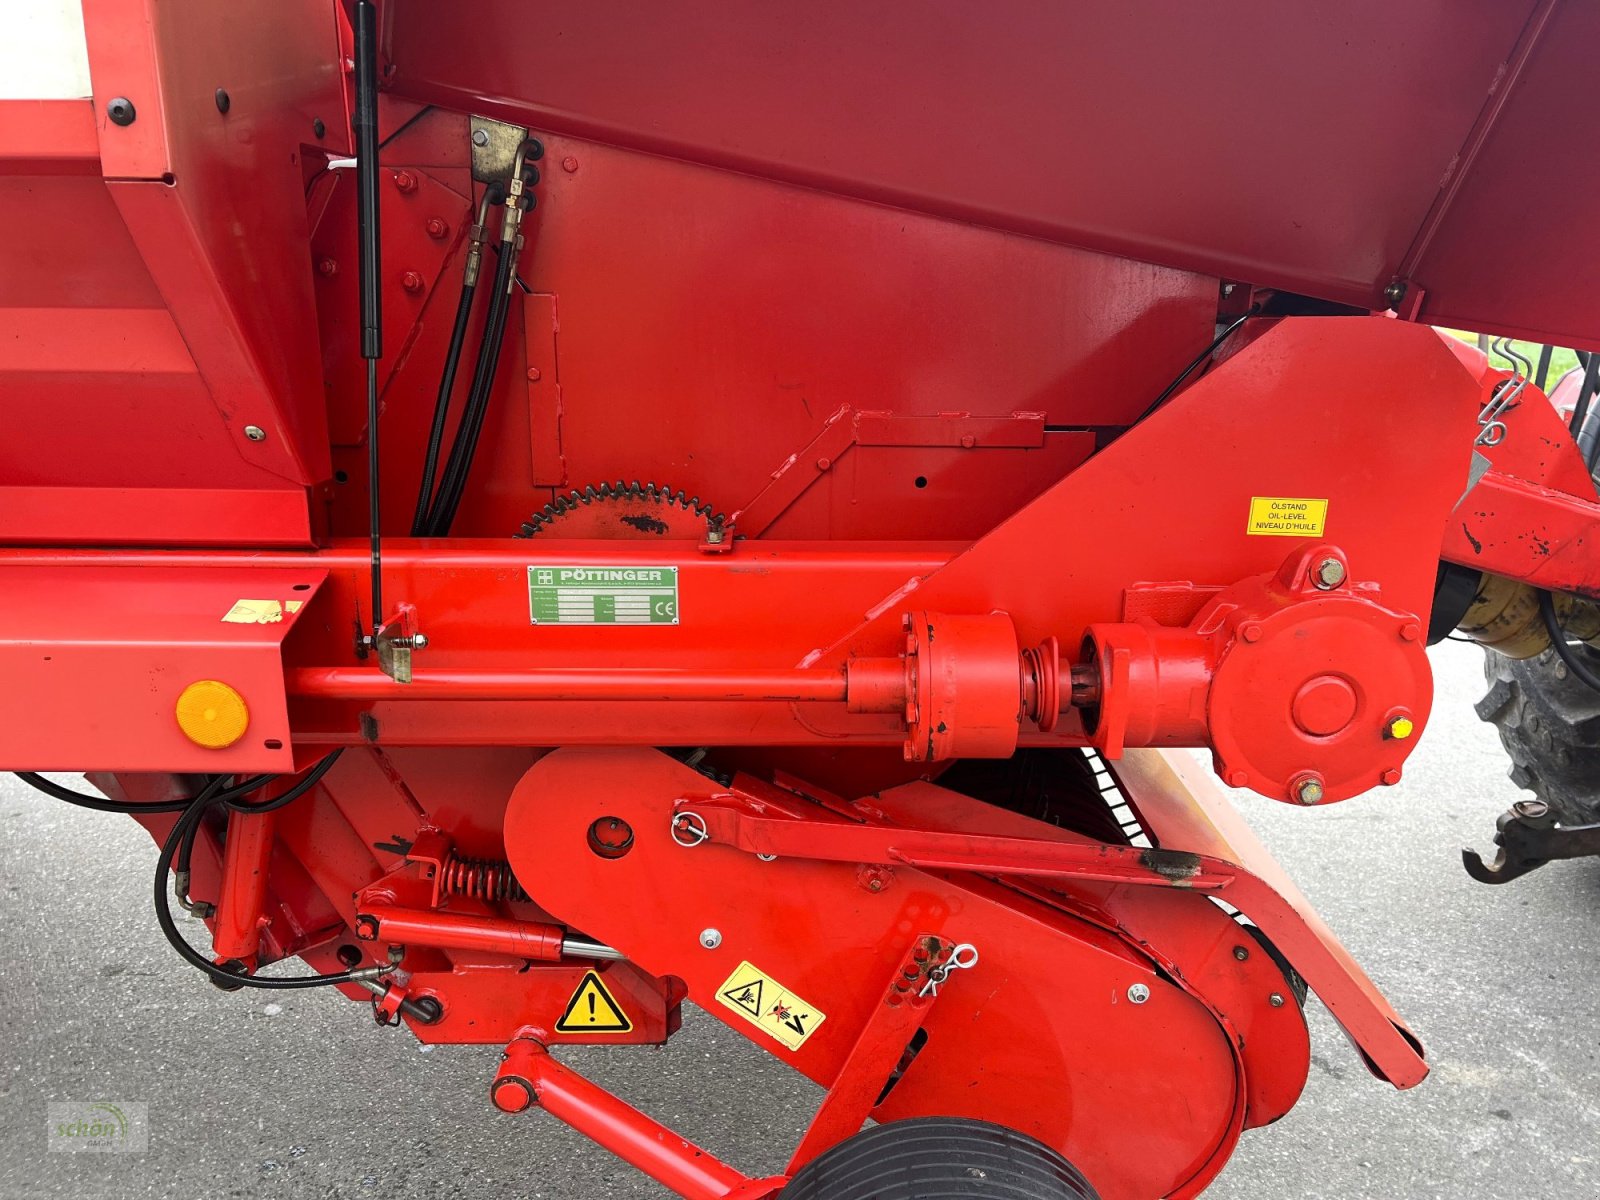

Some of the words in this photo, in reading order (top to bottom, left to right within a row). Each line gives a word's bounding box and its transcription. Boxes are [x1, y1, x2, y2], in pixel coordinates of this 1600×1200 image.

[1271, 502, 1307, 511] ÖLSTAND
[1268, 512, 1307, 520] OIL-LEVEL
[1256, 522, 1284, 530] NIVEAU
[1286, 523, 1316, 531] D'HUILE
[560, 569, 662, 581] PÖTTINGER
[655, 602, 674, 616] CE
